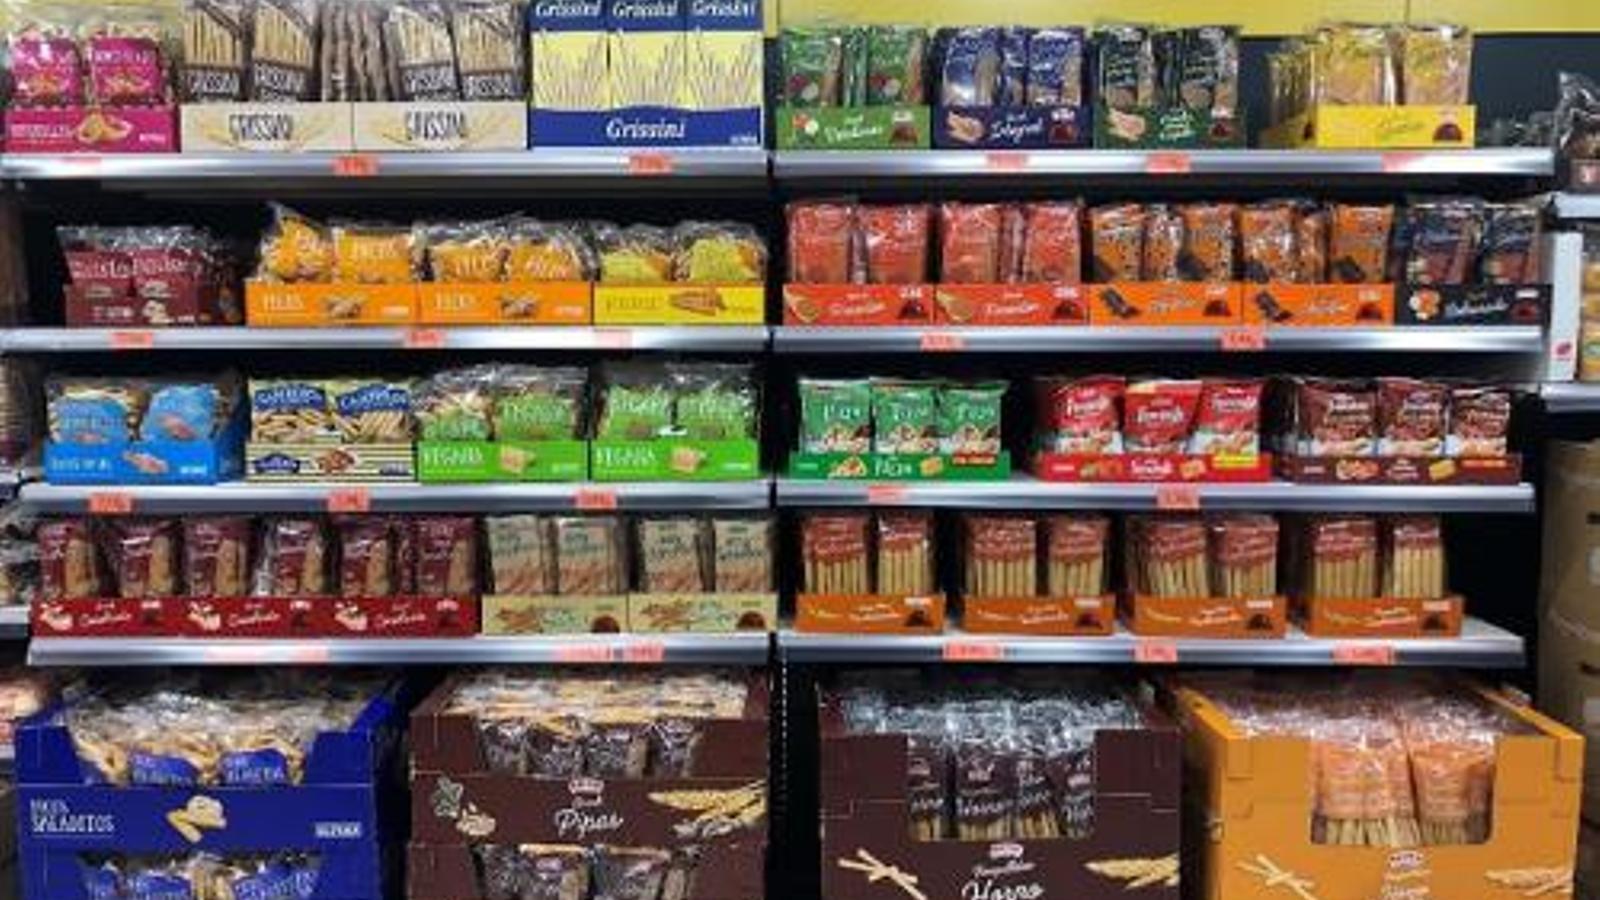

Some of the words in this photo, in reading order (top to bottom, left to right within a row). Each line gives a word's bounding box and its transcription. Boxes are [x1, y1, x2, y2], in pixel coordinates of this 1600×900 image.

[534, 0, 601, 17] Grissini
[606, 118, 685, 139] Grissini
[555, 808, 624, 839] Pipas
